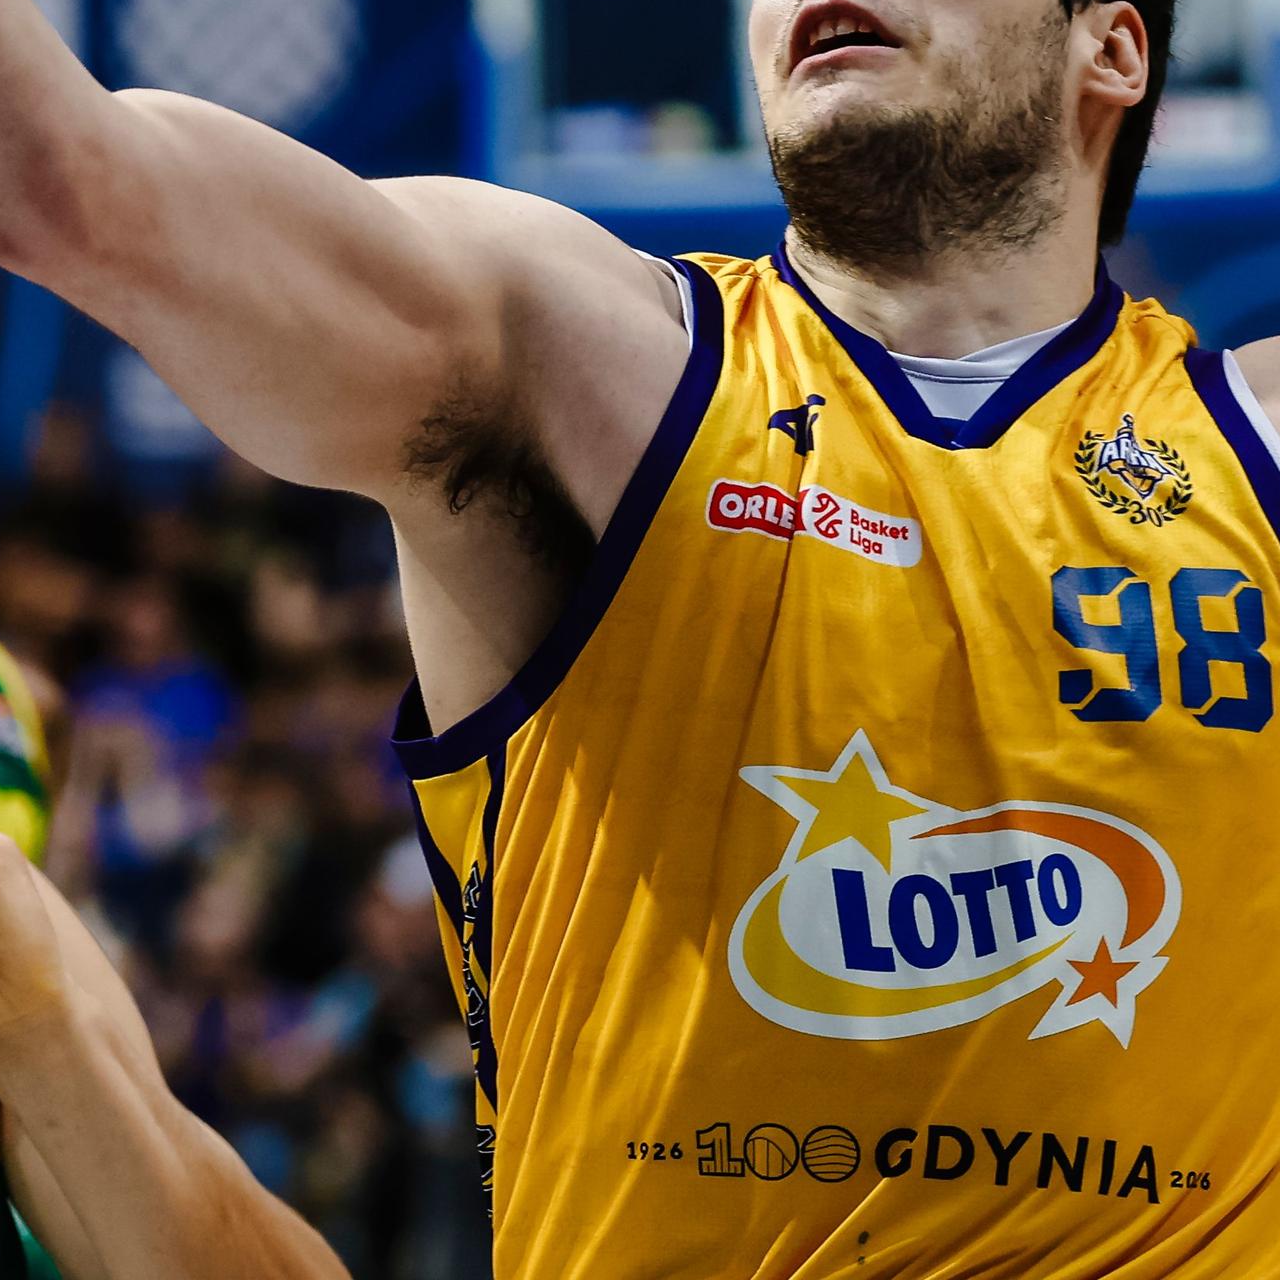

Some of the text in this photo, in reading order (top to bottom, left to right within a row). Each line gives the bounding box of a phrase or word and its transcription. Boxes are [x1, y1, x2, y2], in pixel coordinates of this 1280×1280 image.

[719, 492, 797, 531] ORLE
[849, 527, 884, 555] Liga
[850, 508, 909, 541] Basket
[1051, 566, 1274, 733] 98
[831, 852, 1083, 973] LOTTO
[627, 1141, 683, 1161] 1926
[696, 1122, 861, 1183] 100
[874, 1124, 1160, 1204] GDYNIA
